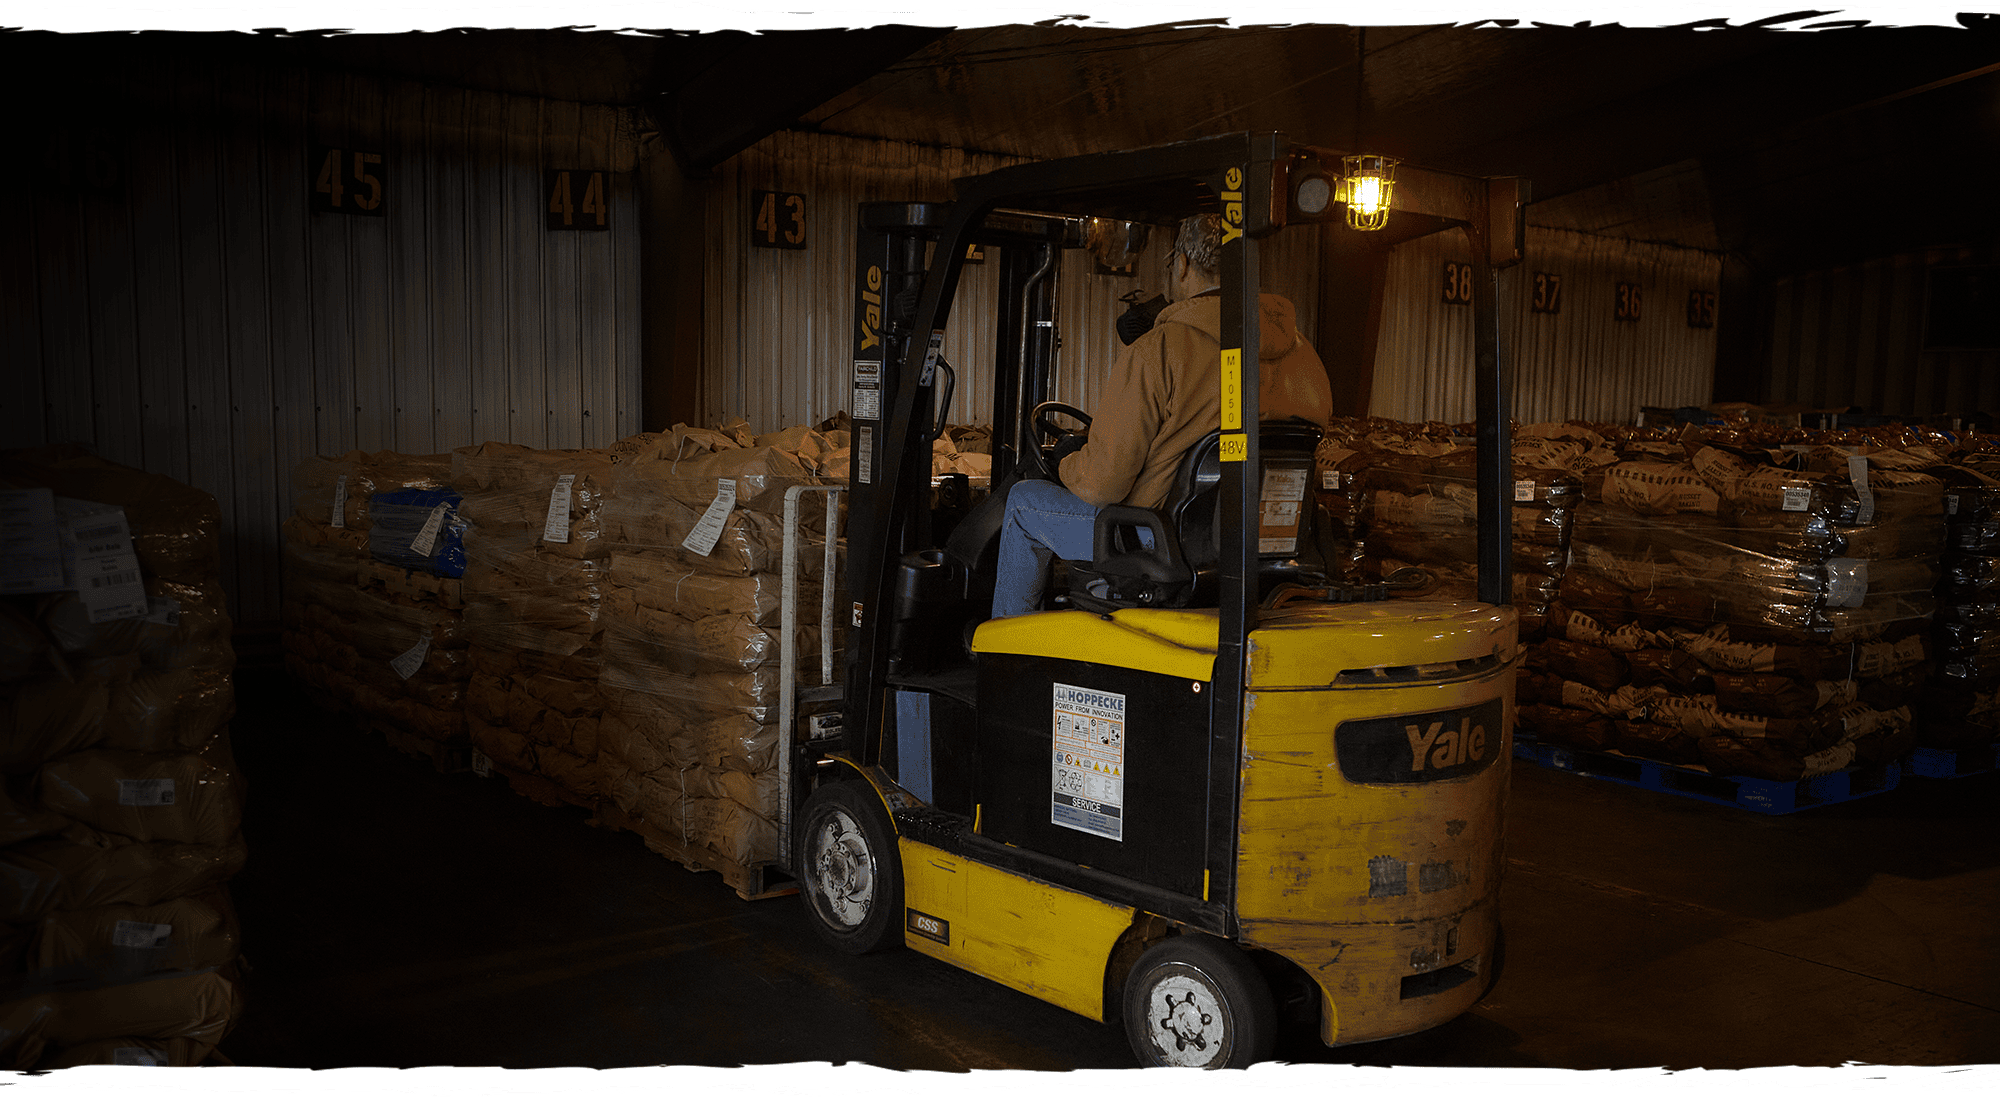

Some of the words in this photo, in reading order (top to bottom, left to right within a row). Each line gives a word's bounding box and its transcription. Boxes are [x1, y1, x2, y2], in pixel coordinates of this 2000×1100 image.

[314, 148, 383, 211] 45
[549, 171, 607, 226] 44
[755, 193, 806, 244] 43
[1221, 165, 1244, 246] Yale
[1445, 263, 1473, 302] 38
[1534, 274, 1561, 311] 37
[1617, 284, 1641, 318] 36
[860, 264, 883, 351] Yale
[1691, 291, 1716, 323] 35
[1220, 440, 1245, 455] 48V
[1055, 701, 1074, 711] POWER
[1075, 705, 1090, 714] FROM
[1091, 708, 1124, 720] INNOVATION
[1068, 690, 1124, 711] HOPPECKE
[1405, 717, 1486, 772] Yale
[1072, 796, 1102, 813] SERVICE
